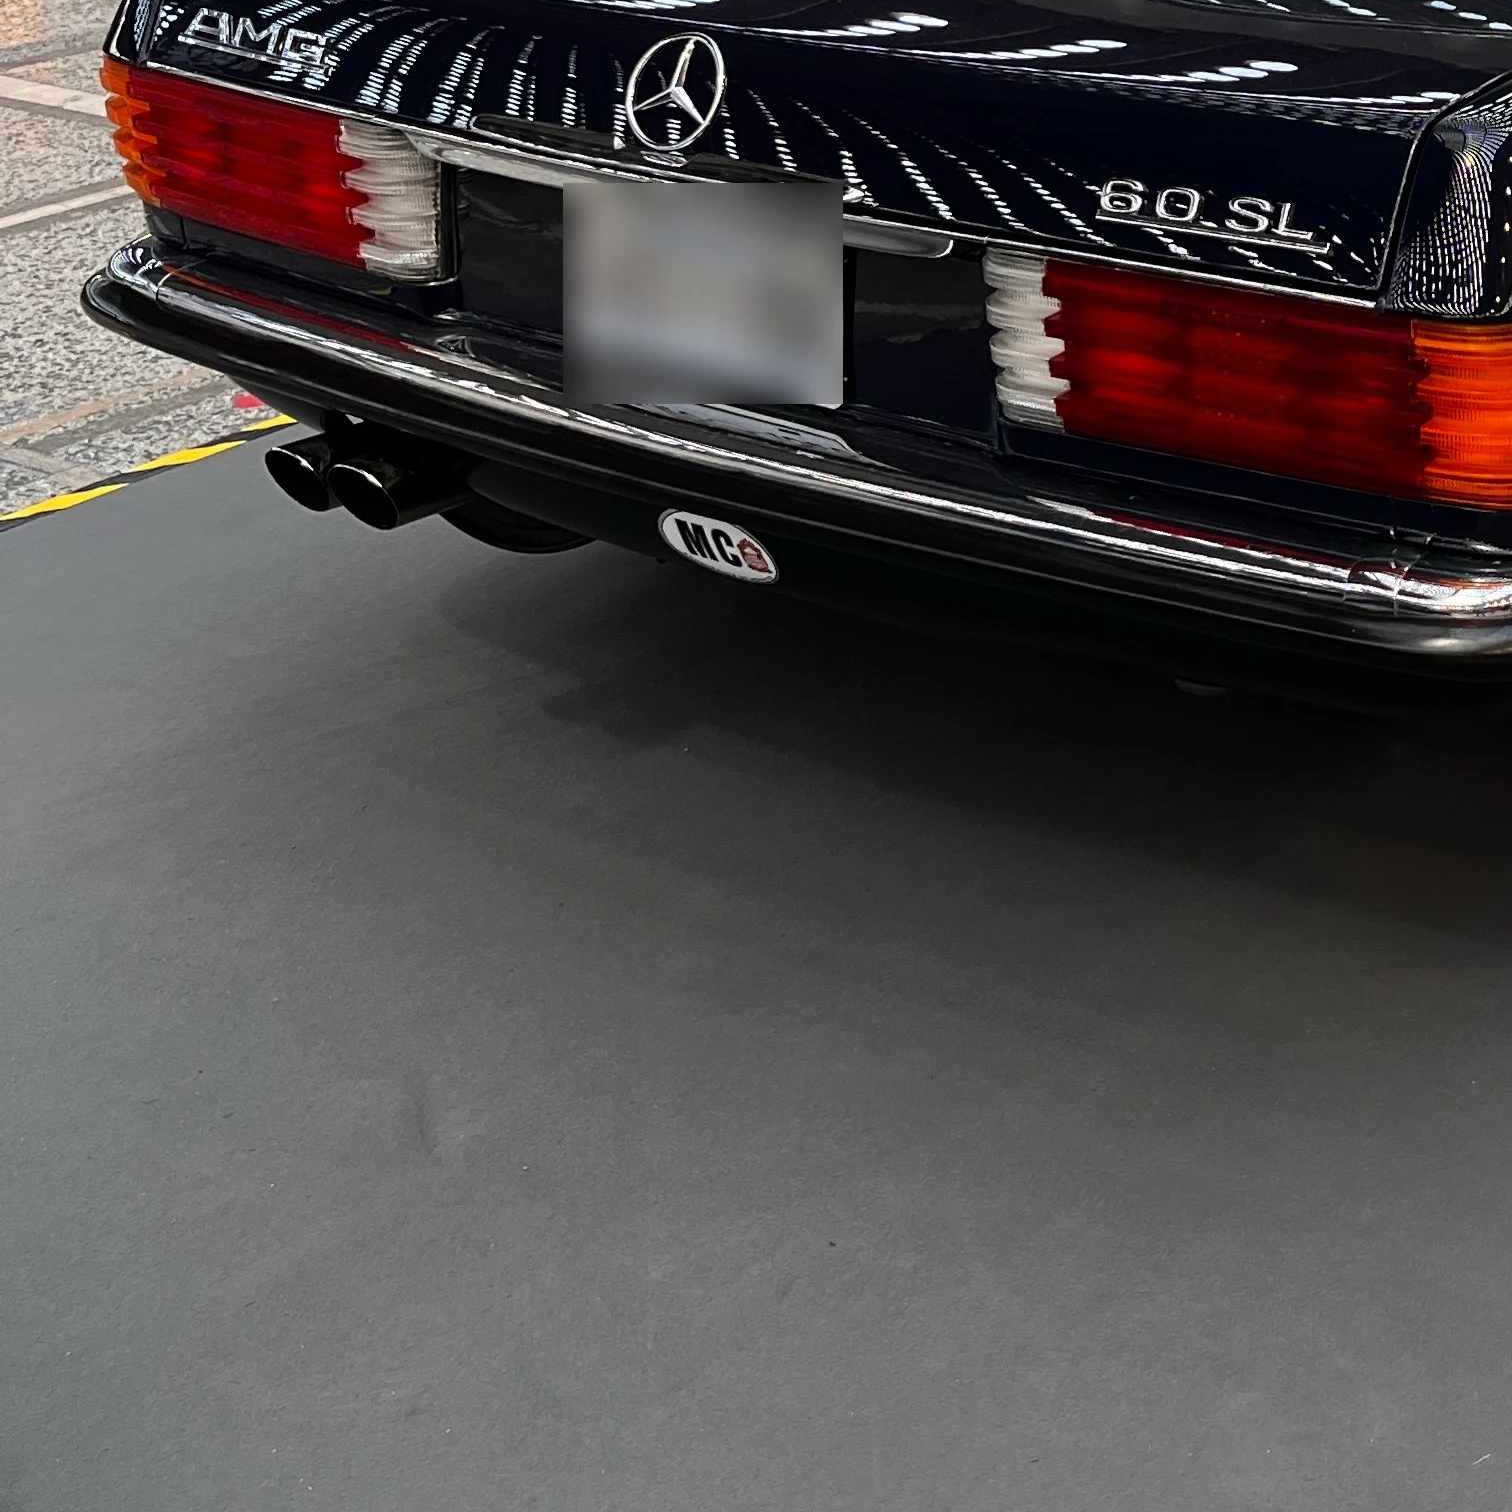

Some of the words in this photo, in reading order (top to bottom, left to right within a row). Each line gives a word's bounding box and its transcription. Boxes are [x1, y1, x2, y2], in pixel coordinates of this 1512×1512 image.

[181, 7, 328, 67] AMG
[1100, 178, 1205, 223] 60
[1223, 196, 1316, 241] SL
[673, 517, 743, 568] MC
